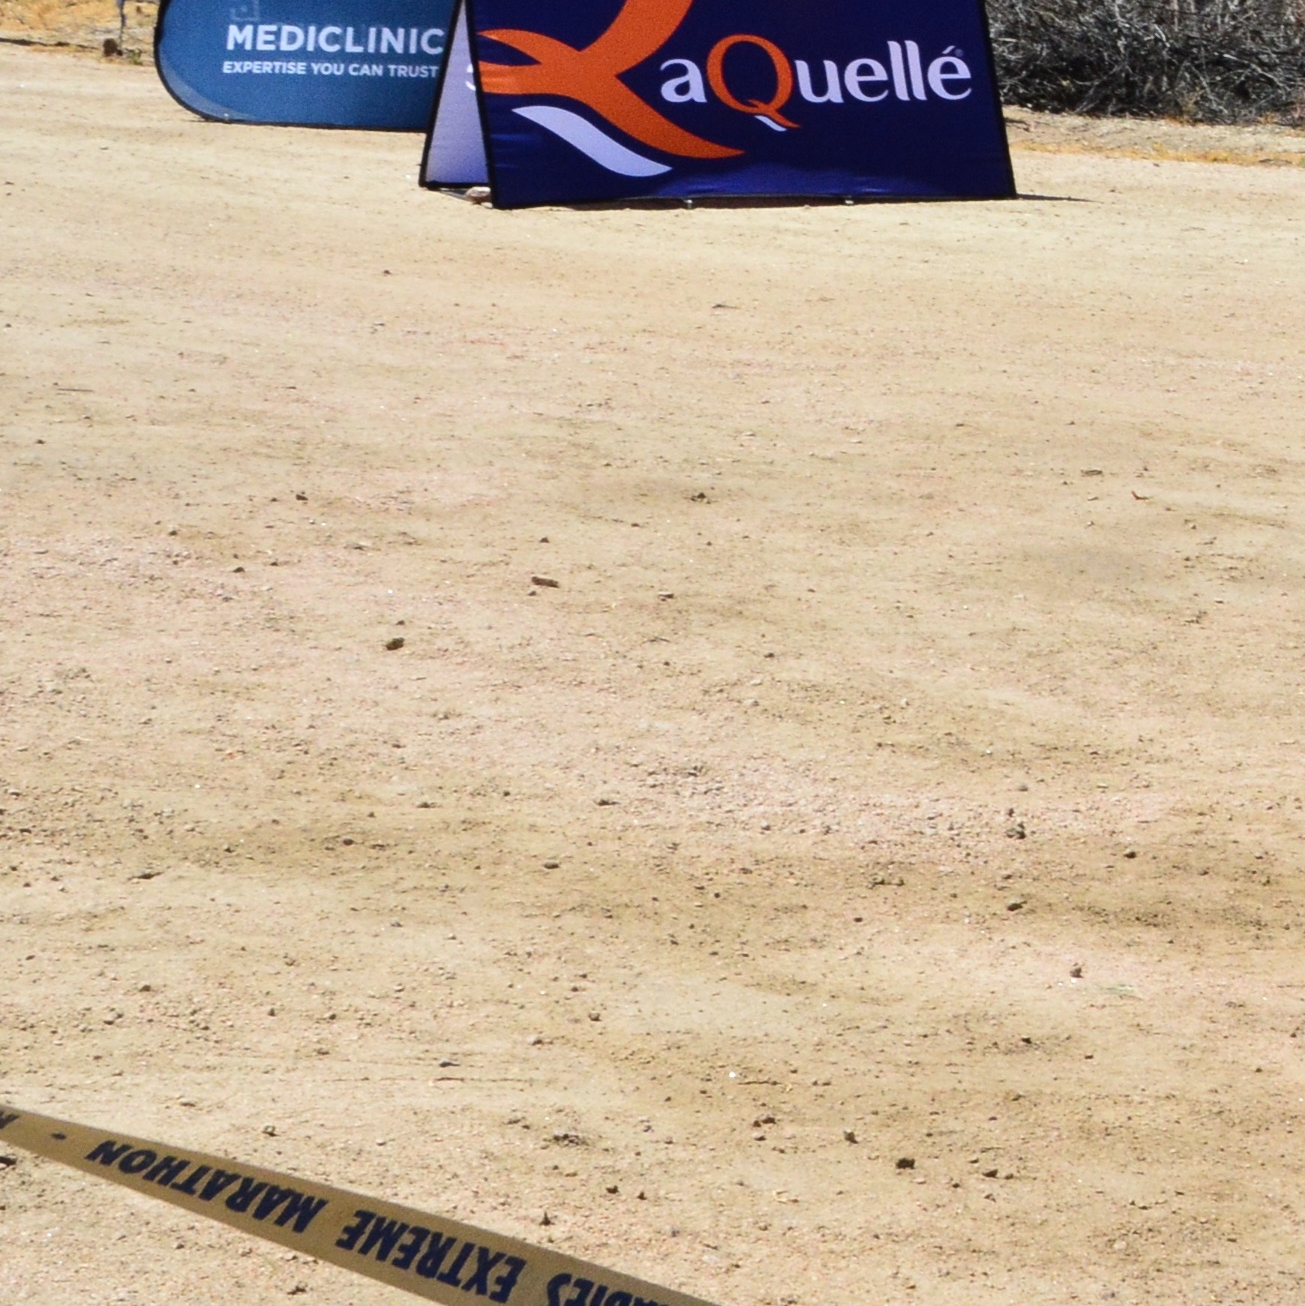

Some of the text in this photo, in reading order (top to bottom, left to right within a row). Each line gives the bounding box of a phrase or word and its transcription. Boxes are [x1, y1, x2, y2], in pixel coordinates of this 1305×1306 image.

[222, 60, 440, 78] EXPERTISE YOU CAN TRUST
[226, 24, 445, 55] MEDICLINIC
[660, 33, 972, 129] aQuellé
[84, 1139, 330, 1234] MARATHON
[334, 1208, 528, 1304] EXTREME
